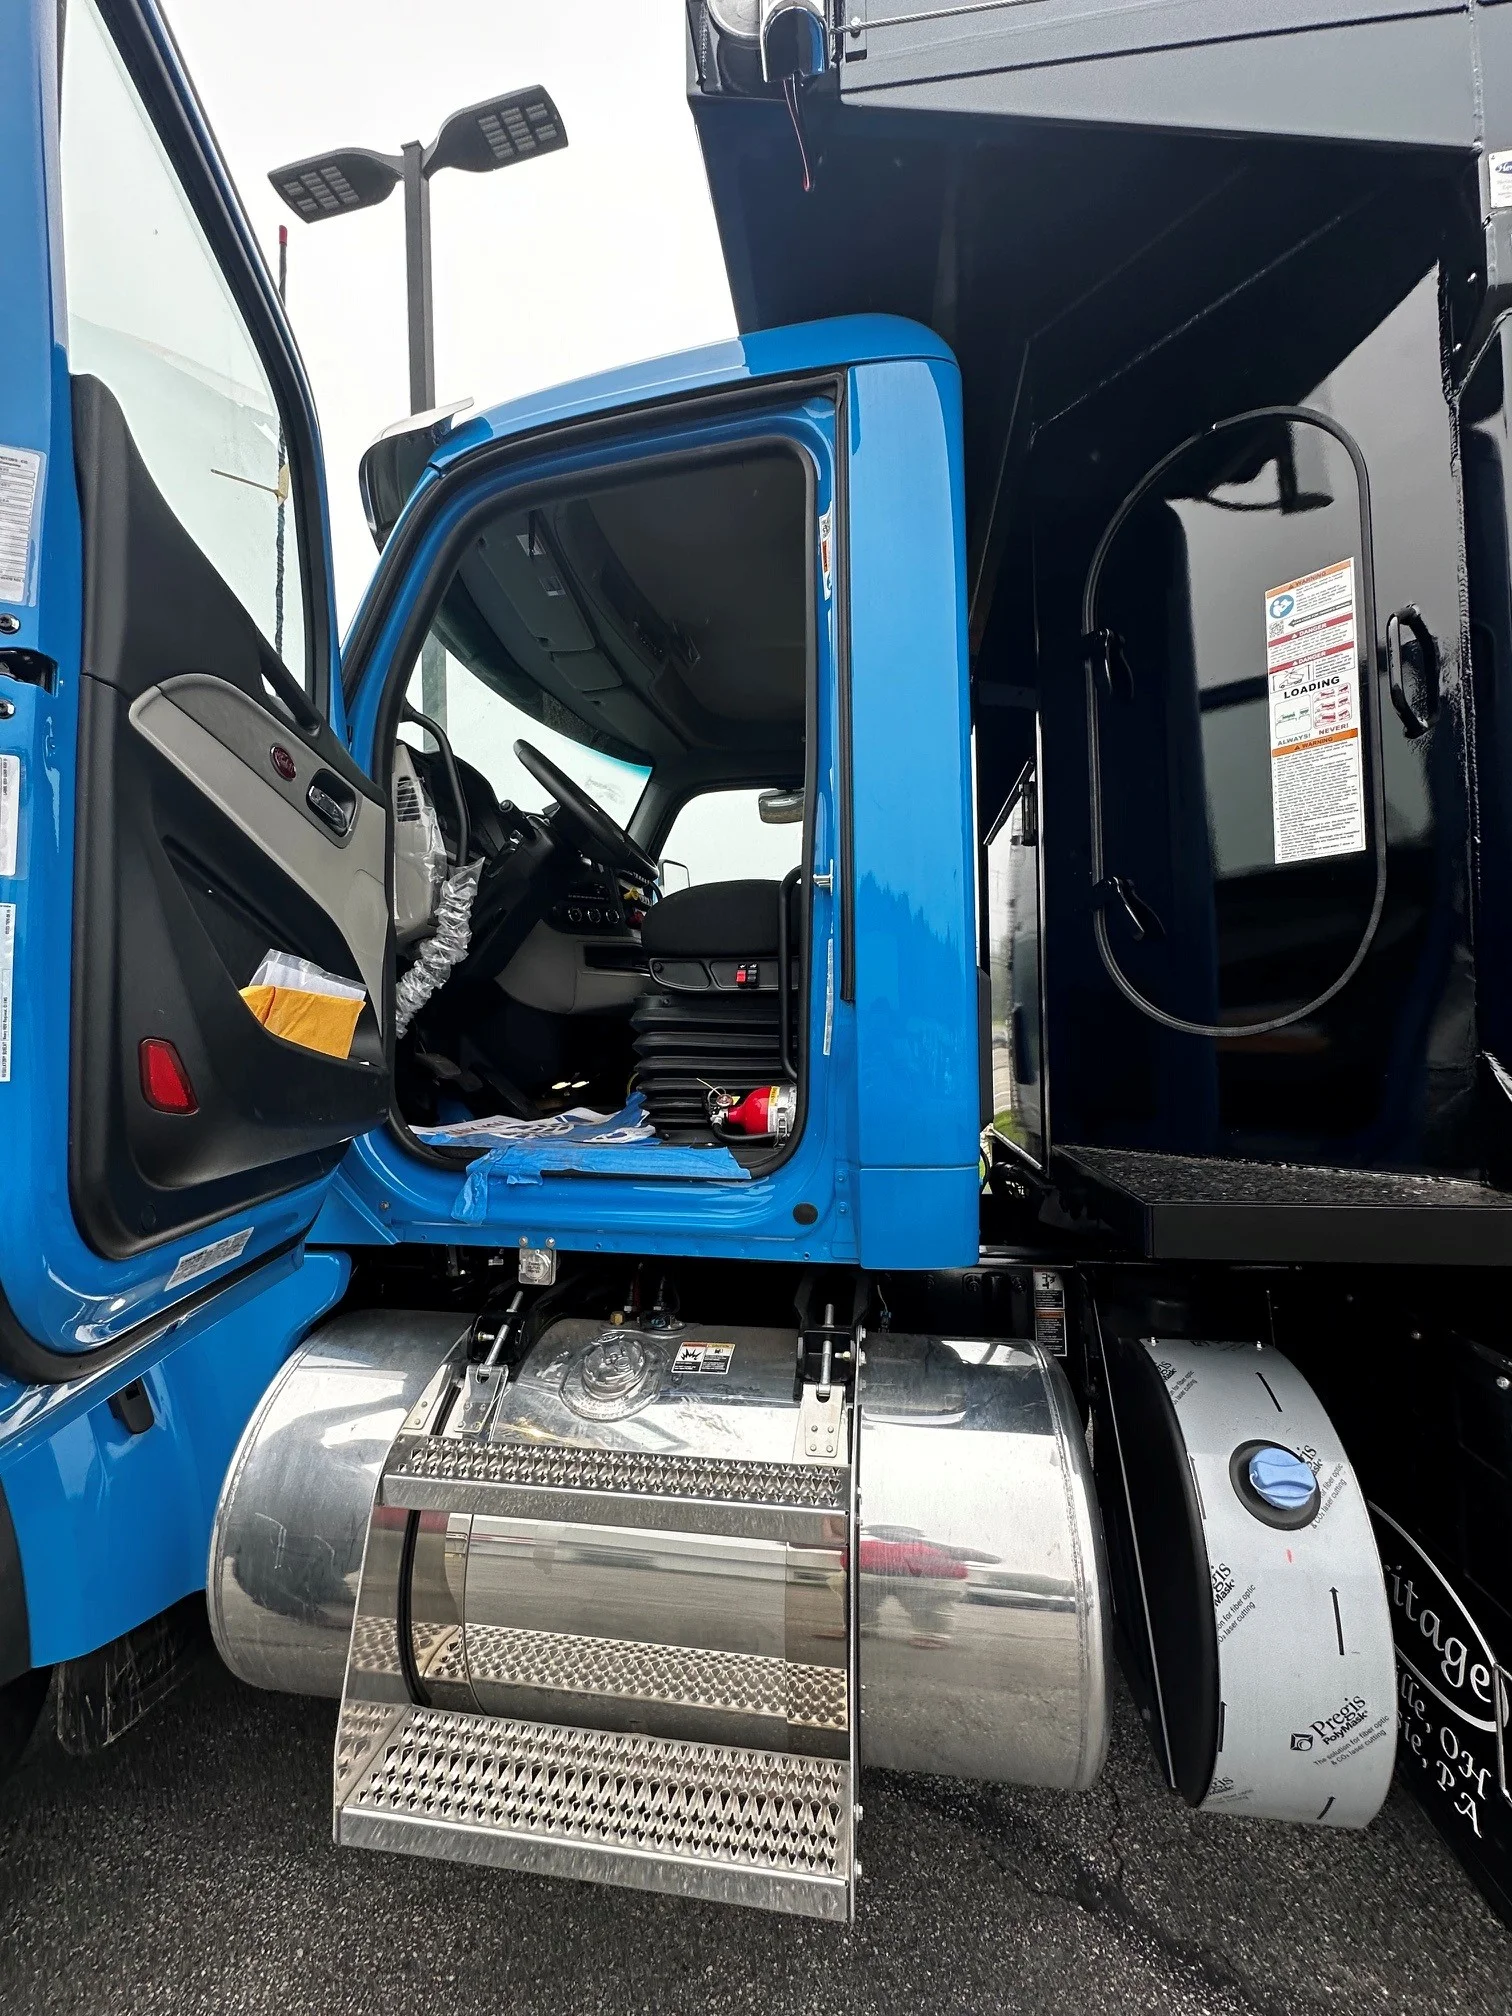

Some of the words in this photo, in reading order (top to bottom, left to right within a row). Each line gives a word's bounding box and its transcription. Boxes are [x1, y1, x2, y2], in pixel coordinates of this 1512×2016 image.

[1299, 622, 1327, 637] DANGER
[1298, 650, 1327, 665] DANGER
[1284, 676, 1341, 699] LOADING
[1277, 733, 1311, 746] ALWAYS!
[1318, 723, 1349, 736] NEVER!
[1301, 736, 1334, 749] WARNING
[1322, 1477, 1335, 1491] fiber
[1332, 1463, 1344, 1478] optic
[1321, 1497, 1334, 1513] laser
[1331, 1478, 1348, 1499] cutting
[1222, 1611, 1233, 1622] for
[1230, 1598, 1244, 1614] fiber
[1242, 1584, 1256, 1600] optic
[1223, 1620, 1238, 1636] laser
[1237, 1601, 1256, 1622] cutting
[1309, 1695, 1366, 1738] Pregis
[1313, 1757, 1327, 1767] The
[1326, 1742, 1352, 1760] solution
[1349, 1737, 1360, 1746] for
[1358, 1726, 1374, 1739] fiber
[1373, 1714, 1390, 1730] optic
[1348, 1744, 1365, 1756] laser
[1364, 1729, 1387, 1746] cutting
